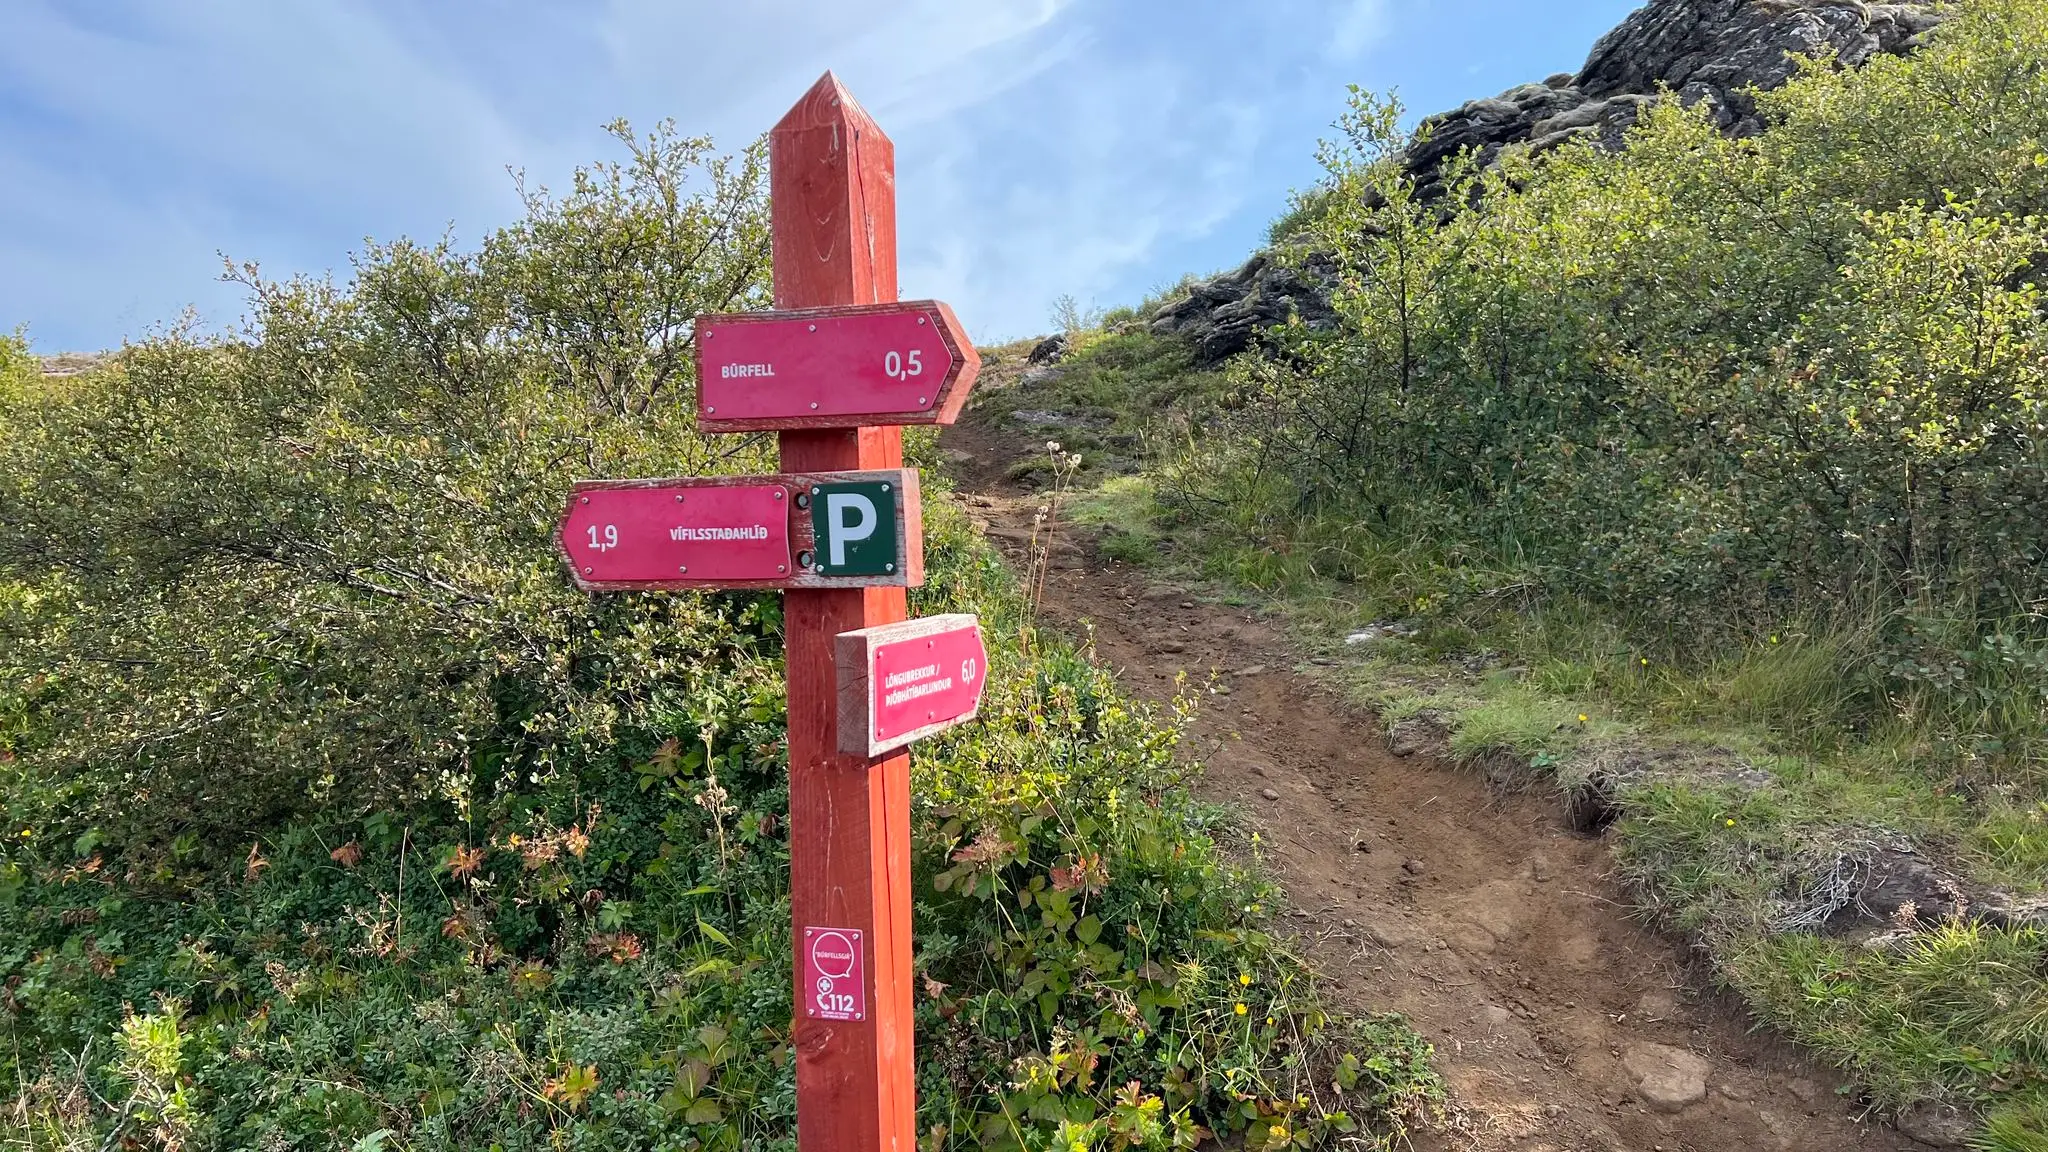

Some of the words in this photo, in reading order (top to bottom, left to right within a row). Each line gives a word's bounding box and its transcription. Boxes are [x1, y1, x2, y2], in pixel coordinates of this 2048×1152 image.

[721, 363, 775, 379] BÚRFELL
[884, 350, 923, 381] 0,5
[586, 525, 619, 553] 1,9
[669, 526, 769, 541] VÍFILSSTAÐAHLÍÐ
[826, 493, 878, 566] P
[885, 665, 935, 688] LÖNGUBREKKUR
[961, 658, 976, 685] 6,0
[829, 994, 854, 1012] 112
